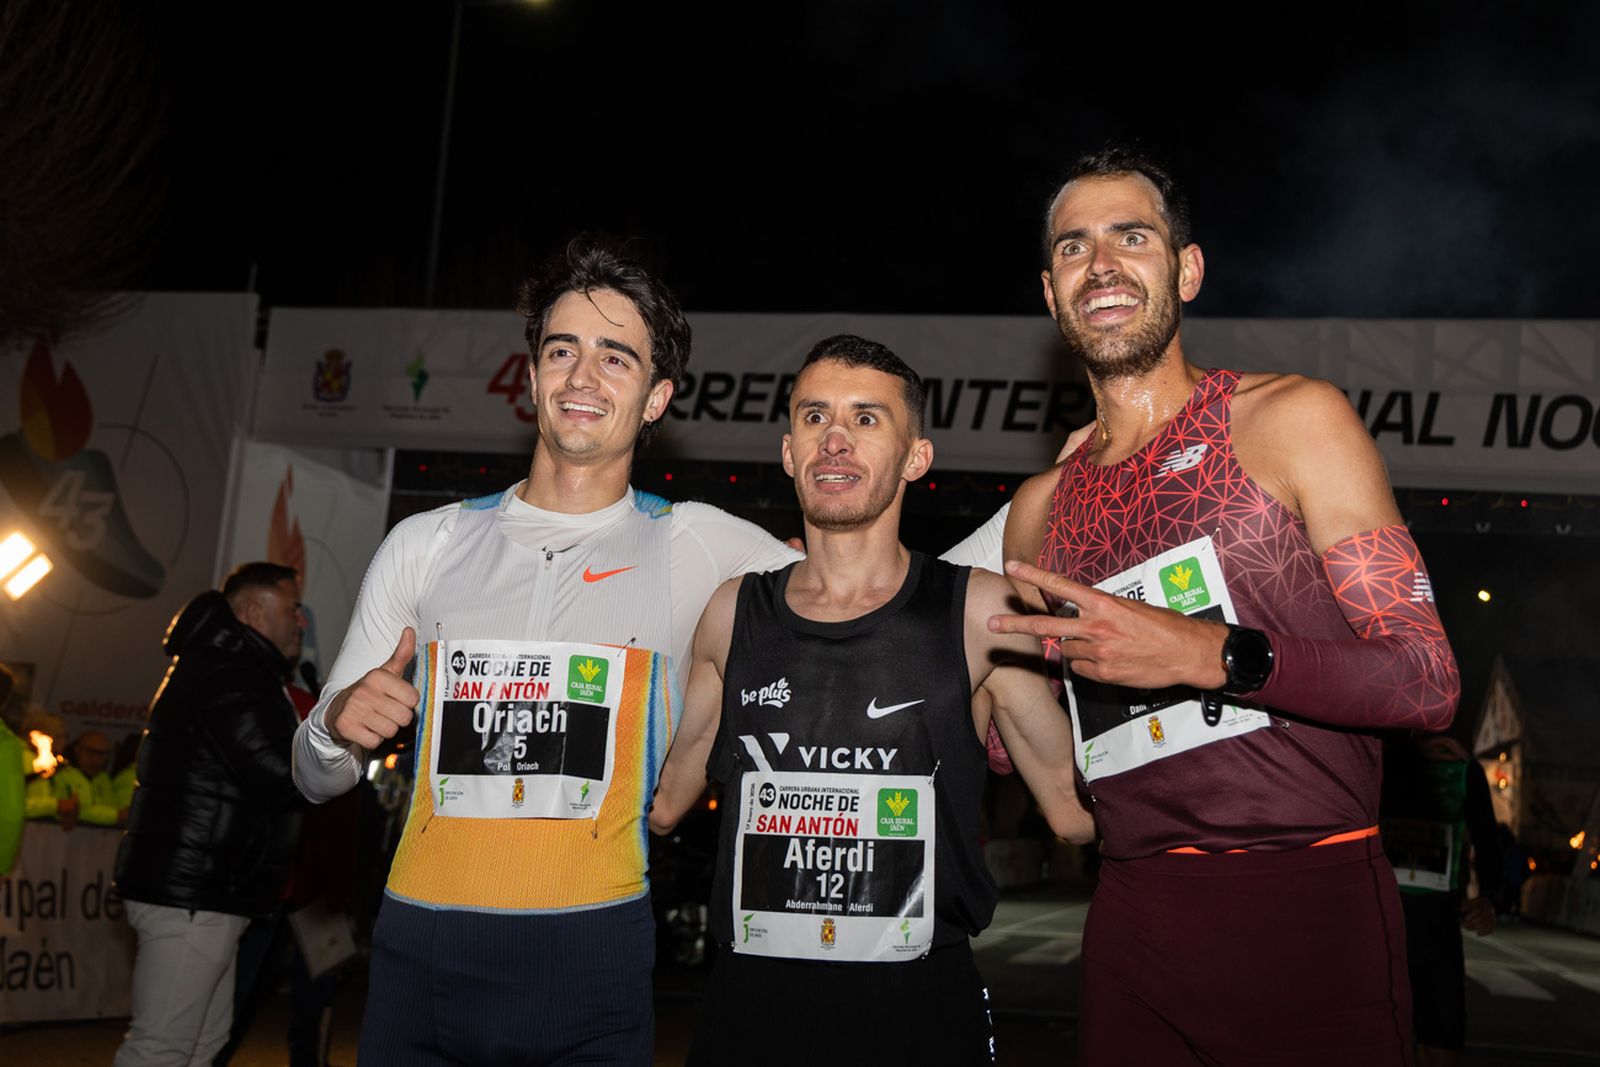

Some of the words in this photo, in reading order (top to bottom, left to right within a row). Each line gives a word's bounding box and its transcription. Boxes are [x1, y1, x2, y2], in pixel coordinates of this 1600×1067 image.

[1482, 394, 1600, 450] NO
[38, 470, 115, 551] 43
[452, 656, 465, 669] 43
[528, 661, 552, 678] DE
[452, 681, 484, 700] SAN
[486, 677, 550, 700] ANTÓN
[473, 702, 567, 734] Oriach
[513, 735, 528, 760] 5
[798, 746, 899, 771] VICKY
[497, 761, 511, 771] Pol
[516, 761, 540, 772] Oriach
[760, 788, 775, 801] 43
[779, 785, 800, 793] CARRERA
[801, 786, 821, 794] URBANA
[821, 787, 860, 796] INTERNACIONAL
[778, 793, 835, 812] NOCHE
[838, 795, 860, 813] DE
[756, 814, 792, 834] SAN
[795, 812, 860, 837] ANTÓN
[880, 817, 895, 826] CAJA
[895, 817, 915, 827] RURAL
[783, 837, 875, 873] Aferdi
[82, 870, 125, 921] de
[816, 872, 845, 899] 12
[785, 899, 843, 912] Abderrahmane
[849, 902, 874, 913] Aferdi
